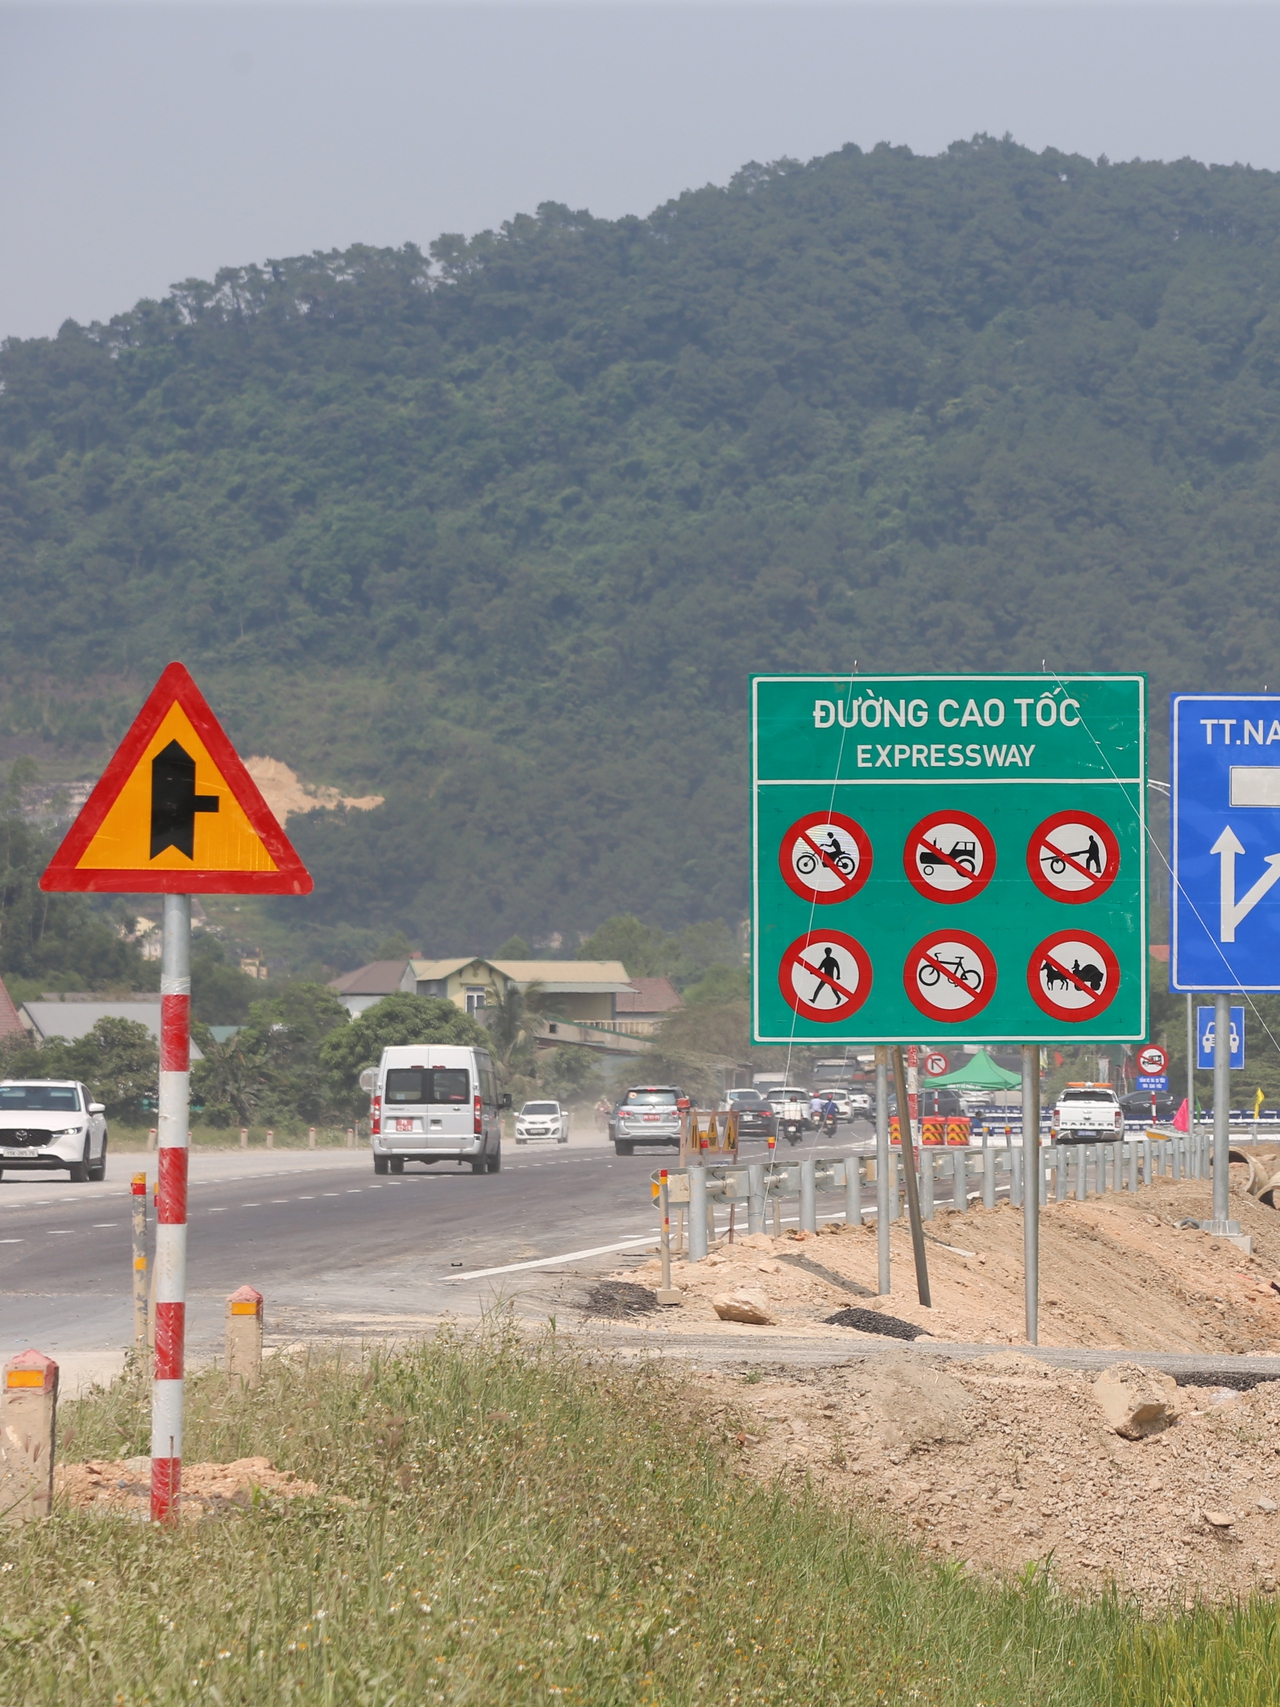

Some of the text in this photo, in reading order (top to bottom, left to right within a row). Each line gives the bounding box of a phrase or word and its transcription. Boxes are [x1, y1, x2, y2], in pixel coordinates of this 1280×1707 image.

[812, 687, 1081, 728] ĐƯỜNG CAO TỐC
[856, 744, 1036, 768] EXPRESSWAY
